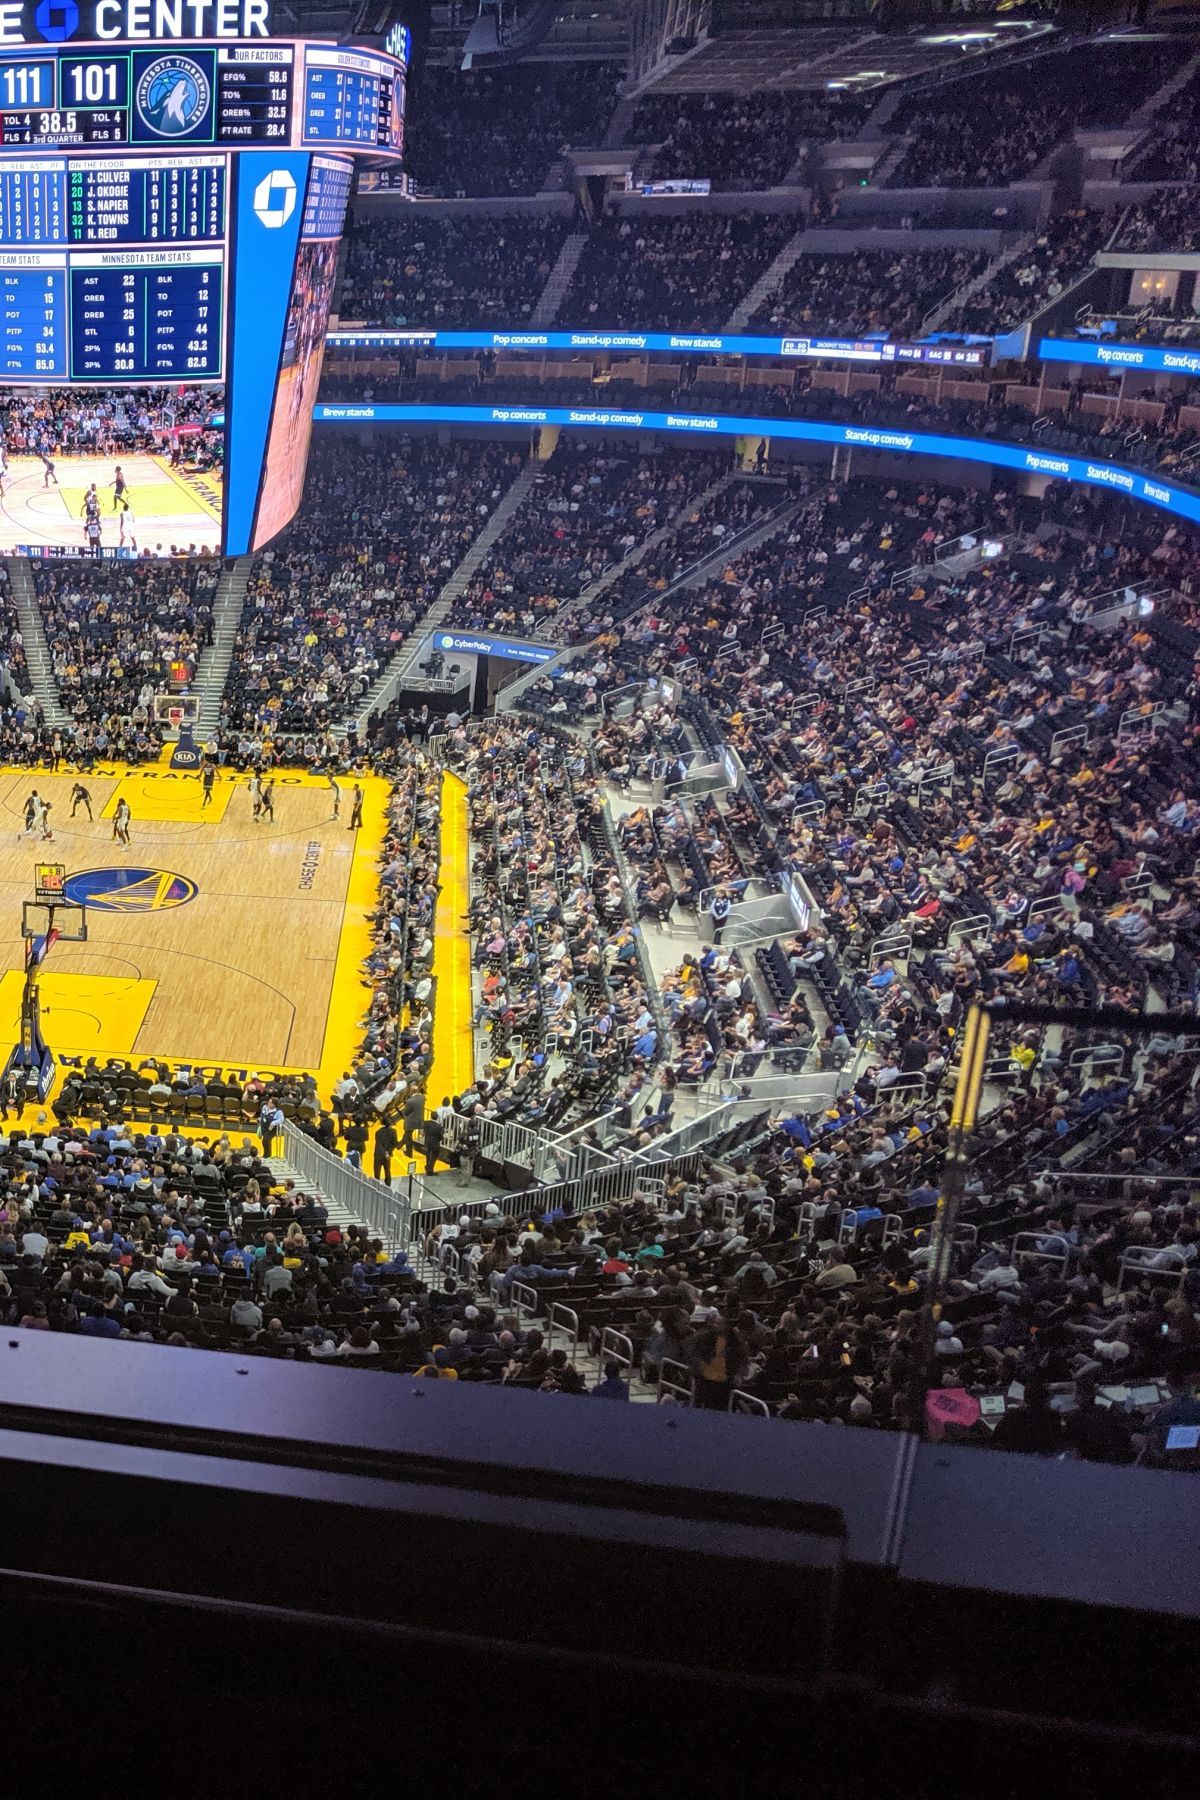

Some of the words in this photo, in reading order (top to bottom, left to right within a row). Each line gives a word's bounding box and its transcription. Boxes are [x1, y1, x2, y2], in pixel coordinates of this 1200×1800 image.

[95, 0, 269, 39] CENTER
[231, 51, 249, 61] OUR
[251, 51, 283, 60] FACTORS
[71, 64, 117, 101] 101
[223, 73, 246, 82] EFG%
[269, 71, 287, 83] 58.6
[4, 67, 40, 104] 111
[141, 61, 172, 109] MINNESOTA
[175, 60, 207, 122] TIMBERWOLVES
[223, 91, 240, 99] TO%
[271, 89, 286, 101] 11.6
[92, 113, 110, 122] TOL
[114, 111, 121, 123] 4
[222, 109, 250, 117] OREB%
[268, 107, 286, 118] 32.5
[4, 117, 20, 125] TOL
[24, 114, 31, 125] 4
[40, 112, 76, 133] 38.5
[93, 131, 109, 139] FLS
[114, 128, 121, 140] 5
[222, 126, 231, 134] FT
[233, 126, 252, 135] RATE
[267, 124, 285, 136] 28.4
[4, 133, 19, 142] FLS
[24, 131, 31, 142] 4
[33, 136, 46, 144] 3rd
[47, 135, 83, 143] QUARTER
[97, 171, 130, 182] CULVER
[97, 186, 128, 197] OKOGIE
[98, 200, 128, 211] NAPIER
[97, 213, 129, 225] TOWNS
[98, 228, 117, 239] REID
[18, 256, 40, 264] STATS
[102, 254, 144, 263] MINNESOTA
[147, 253, 166, 262] TEAM
[168, 253, 191, 262] STATS
[187, 340, 208, 350] 43.2
[494, 335, 510, 346] Pop
[571, 335, 612, 347] Stand-up
[612, 336, 646, 347] comedy
[671, 337, 693, 346] Brew
[693, 338, 721, 347] stands
[1098, 348, 1112, 362] Pop
[1112, 352, 1143, 362] concerts
[1164, 354, 1198, 371] Stand-up
[324, 408, 346, 416] Brew
[346, 408, 374, 416] stands
[493, 410, 509, 421] Pop
[570, 412, 609, 424] Stand-up
[610, 414, 643, 425] comedy
[667, 416, 689, 426] Brew
[689, 419, 717, 428] stands
[845, 430, 880, 444] Stand-up
[880, 436, 912, 448] comedy
[1027, 455, 1040, 468] Pop
[1040, 459, 1068, 472] concerts
[1087, 466, 1117, 485] Stand-up
[1117, 473, 1133, 490] comedy
[1144, 483, 1155, 496] Brew
[1155, 489, 1169, 502] stands
[454, 639, 491, 652] CyberPolicy
[177, 753, 192, 761] KIA
[298, 867, 316, 889] CHASE
